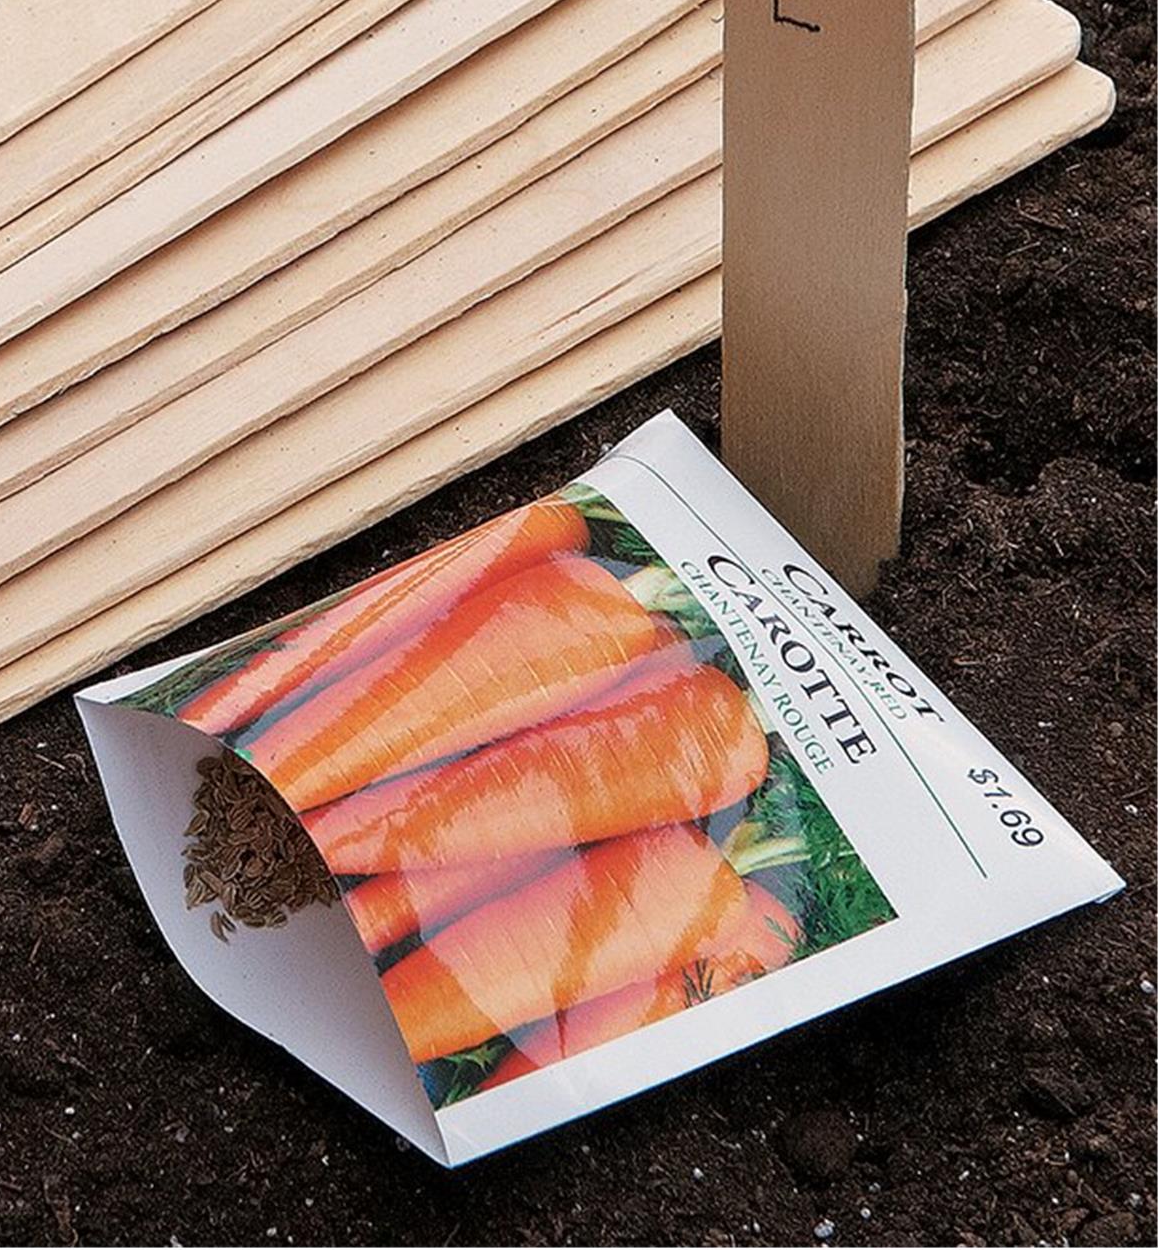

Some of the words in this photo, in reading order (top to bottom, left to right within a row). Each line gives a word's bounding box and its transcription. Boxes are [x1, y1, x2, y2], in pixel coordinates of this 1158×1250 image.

[680, 561, 782, 687] CHANTENAY
[772, 692, 835, 776] ROUGE
[707, 554, 878, 765] CAROTTE
[783, 563, 945, 723] CARROT
[868, 680, 908, 720] RED
[967, 766, 1045, 850] $1.69
